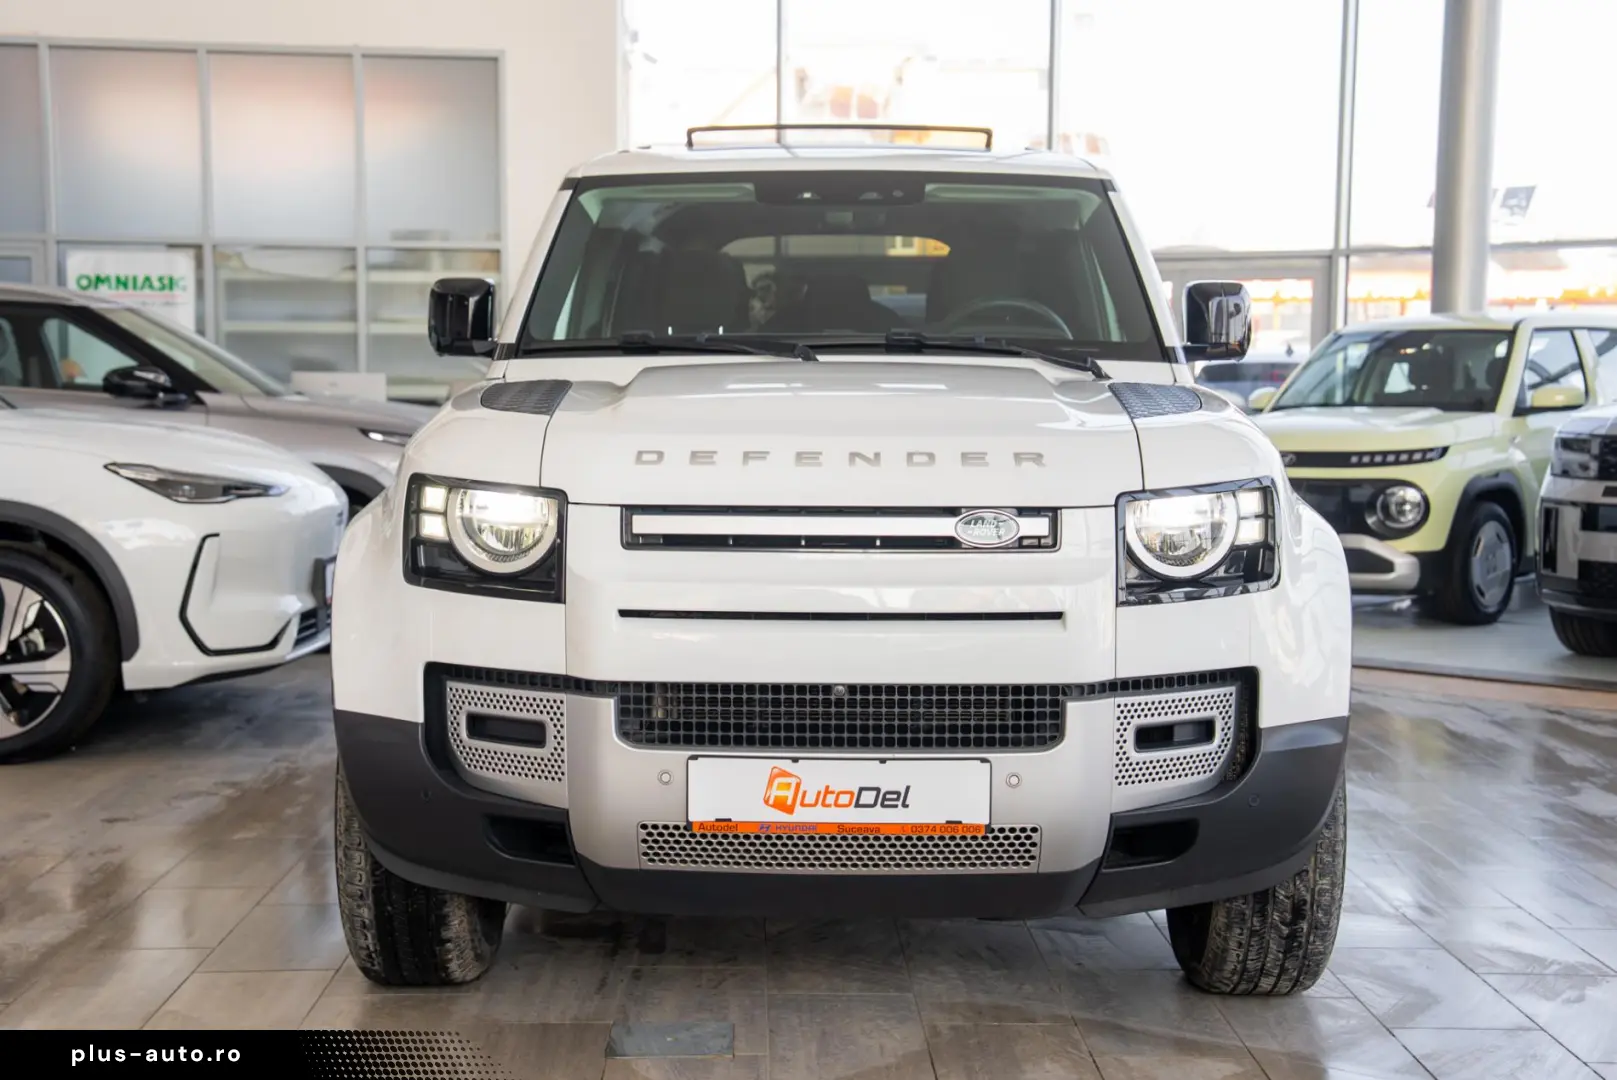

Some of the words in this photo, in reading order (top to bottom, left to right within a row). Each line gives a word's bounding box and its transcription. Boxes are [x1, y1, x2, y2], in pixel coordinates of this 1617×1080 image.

[634, 450, 1047, 468] DEFENDER
[970, 519, 998, 529] LAND
[972, 528, 1006, 537] ROVER
[765, 771, 911, 812] AutoDel
[697, 822, 739, 832] Autodel
[775, 823, 818, 832] HYUNDAI
[837, 824, 881, 834] Suceava
[910, 825, 937, 834] 0374
[939, 825, 960, 834] 006
[961, 825, 981, 834] 006
